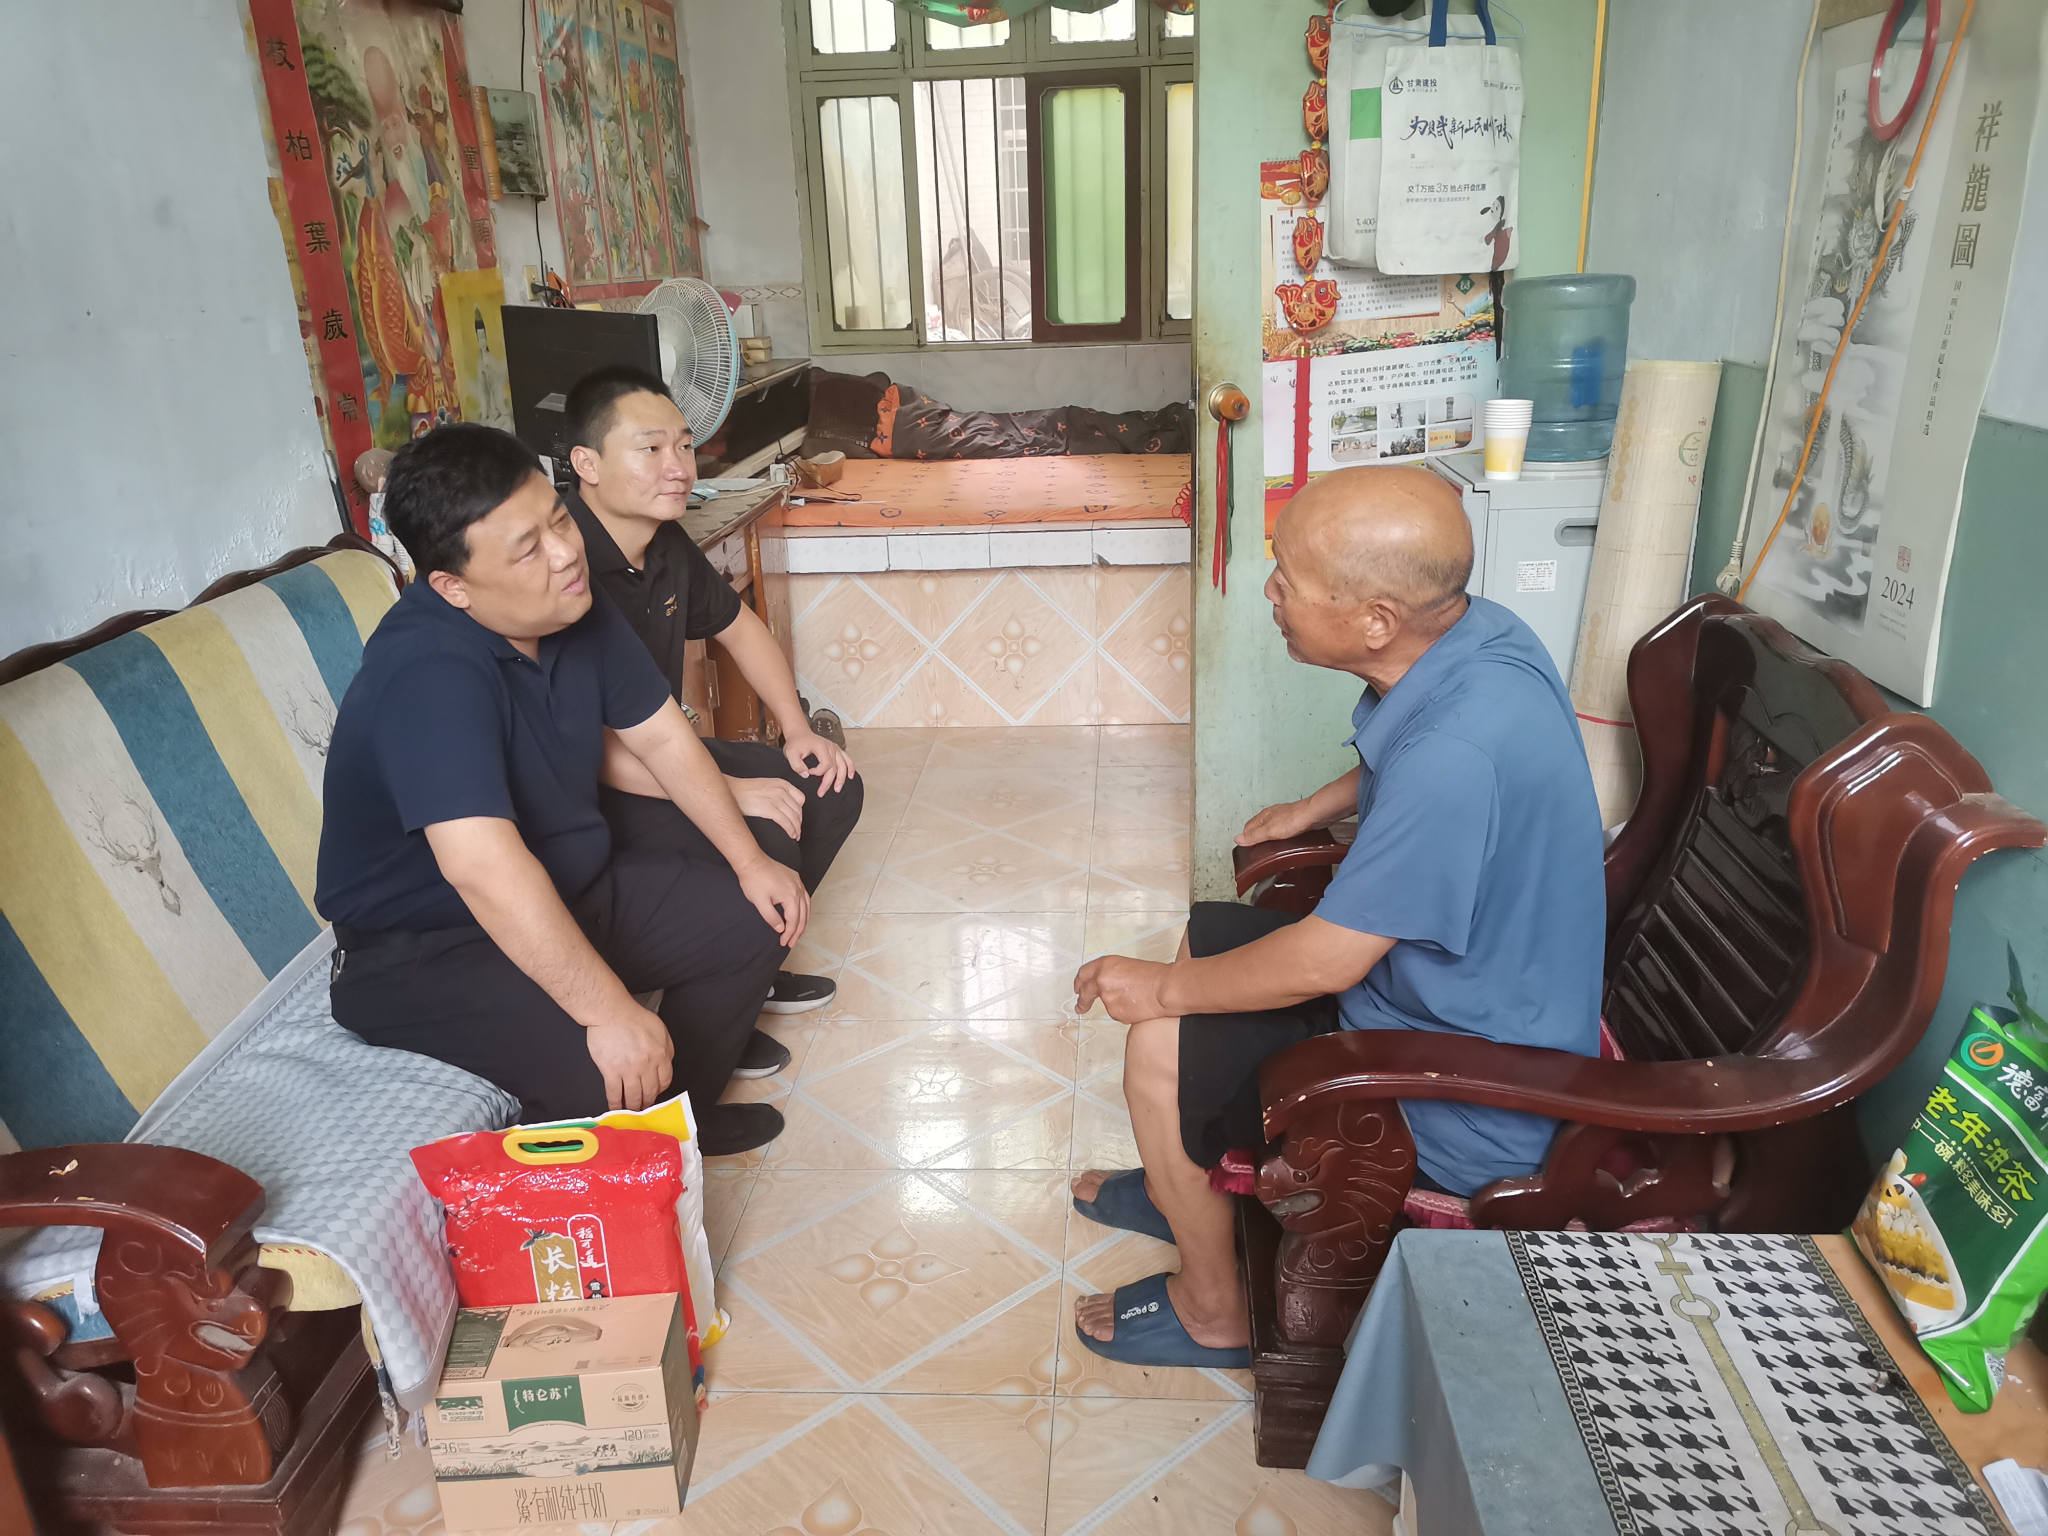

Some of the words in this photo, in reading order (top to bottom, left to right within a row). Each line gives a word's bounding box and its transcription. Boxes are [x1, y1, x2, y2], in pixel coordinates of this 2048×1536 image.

[1950, 100, 2003, 269] 祥龍圖
[1881, 576, 1915, 610] 2024
[1997, 1062, 2048, 1120] 德富
[1925, 1085, 2039, 1201] 老年油茶
[522, 1387, 562, 1402] 特仑苏
[624, 1429, 643, 1441] 120
